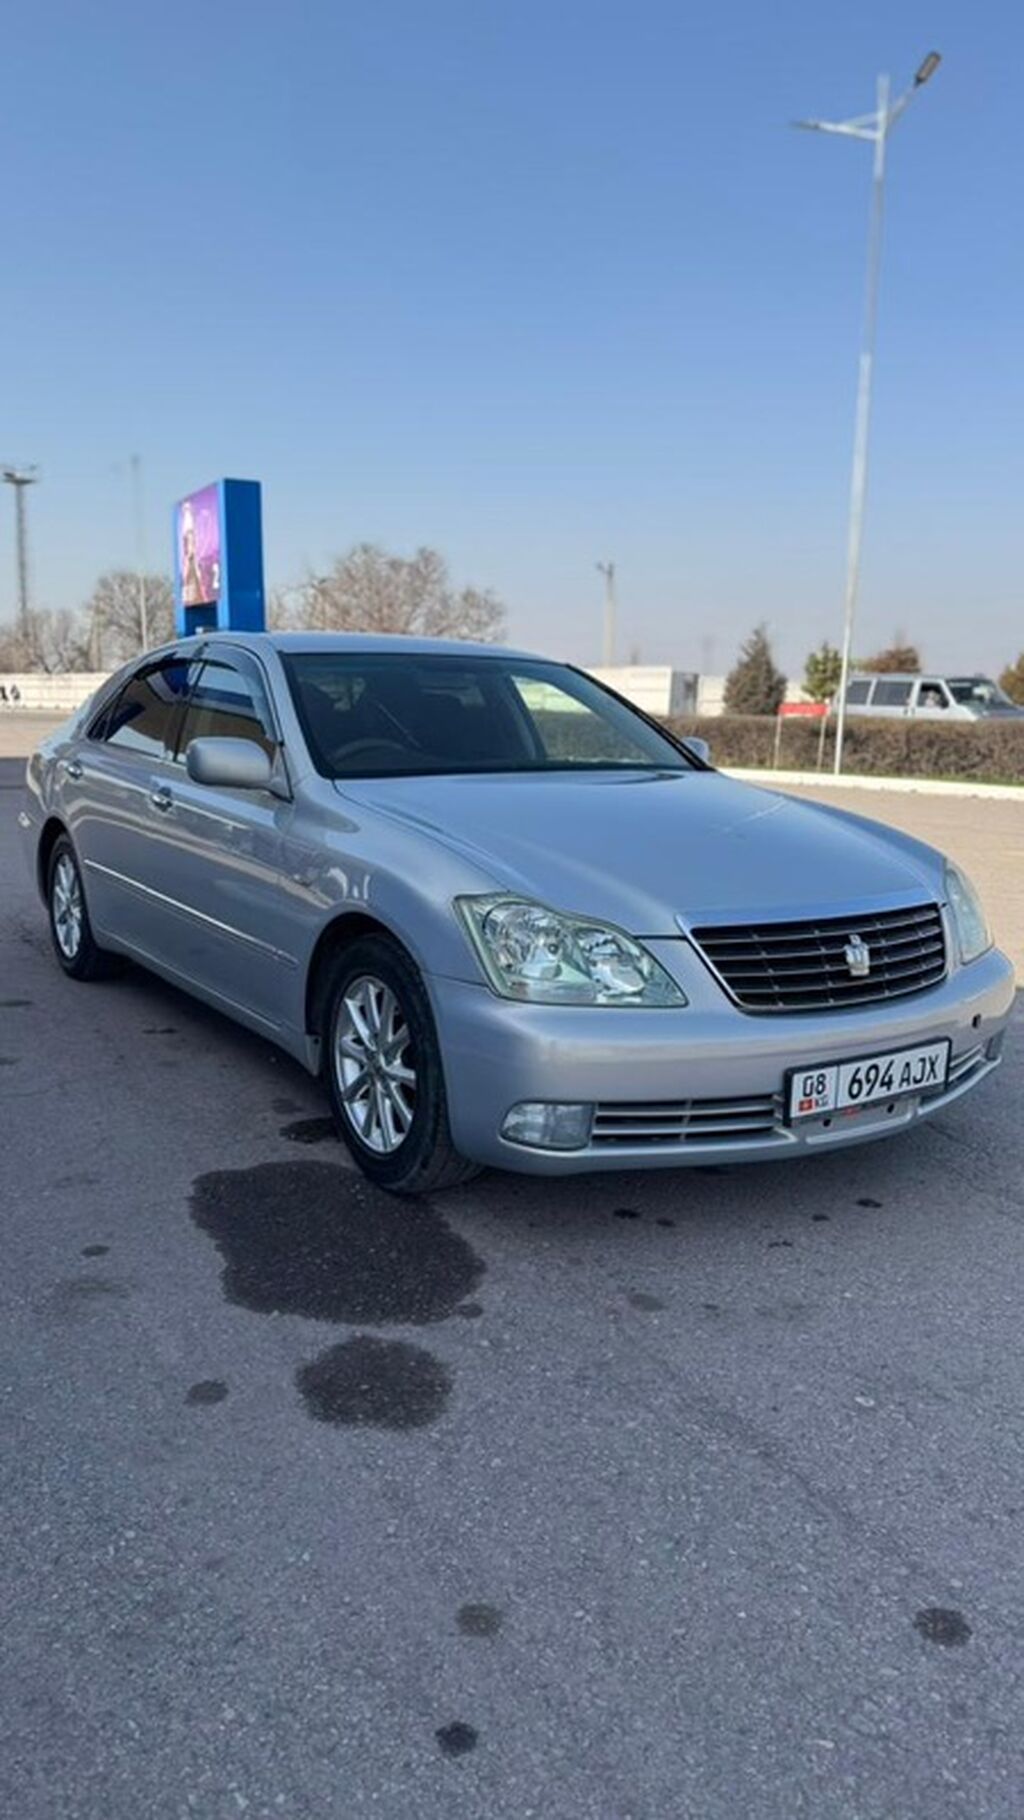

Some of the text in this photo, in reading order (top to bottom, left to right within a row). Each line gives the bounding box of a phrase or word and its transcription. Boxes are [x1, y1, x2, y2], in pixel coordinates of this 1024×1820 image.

[803, 1054, 939, 1099] 08 694 AJX
